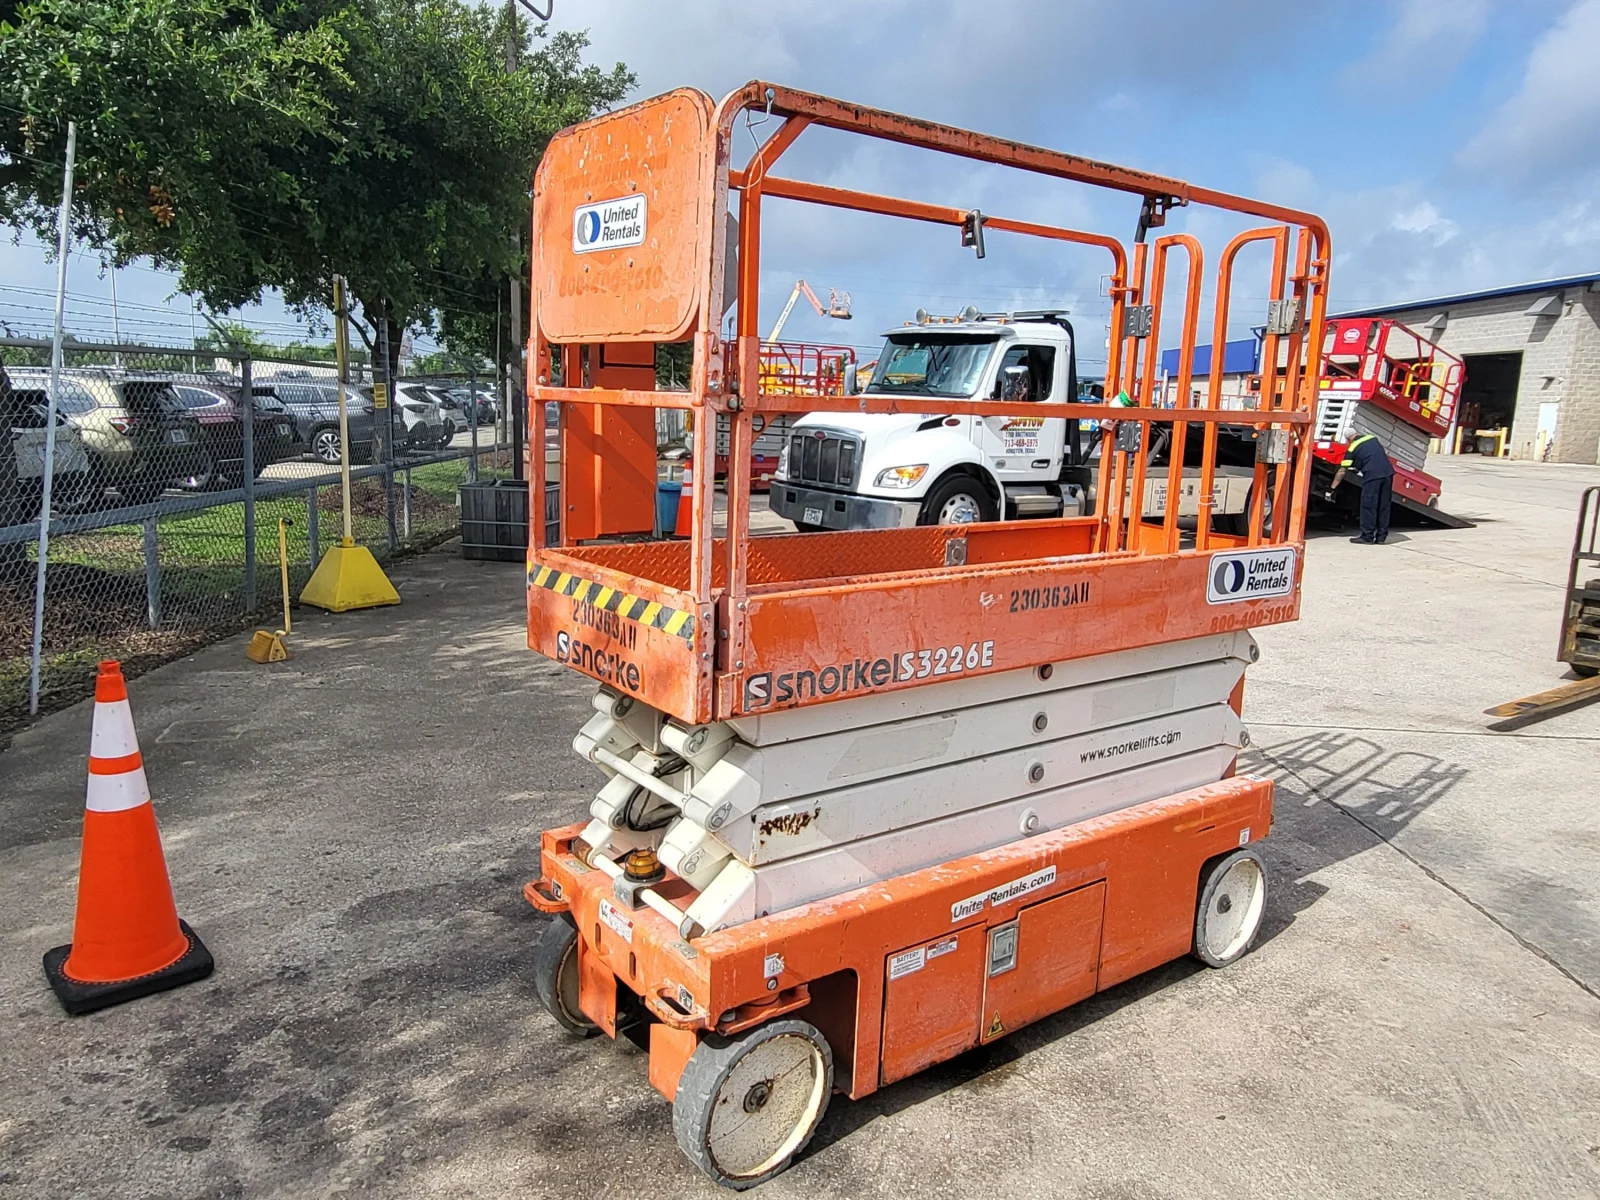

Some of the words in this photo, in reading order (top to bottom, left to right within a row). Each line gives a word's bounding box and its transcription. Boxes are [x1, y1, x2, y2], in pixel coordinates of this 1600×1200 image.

[603, 203, 639, 224] United
[602, 222, 641, 242] Rentals
[1248, 556, 1287, 574] United
[1246, 573, 1288, 592] Rentals
[776, 653, 900, 701] snorkel
[899, 639, 995, 682] S3226E
[1080, 731, 1181, 763] www.snorkellifts.com
[896, 951, 920, 963] BATTERY
